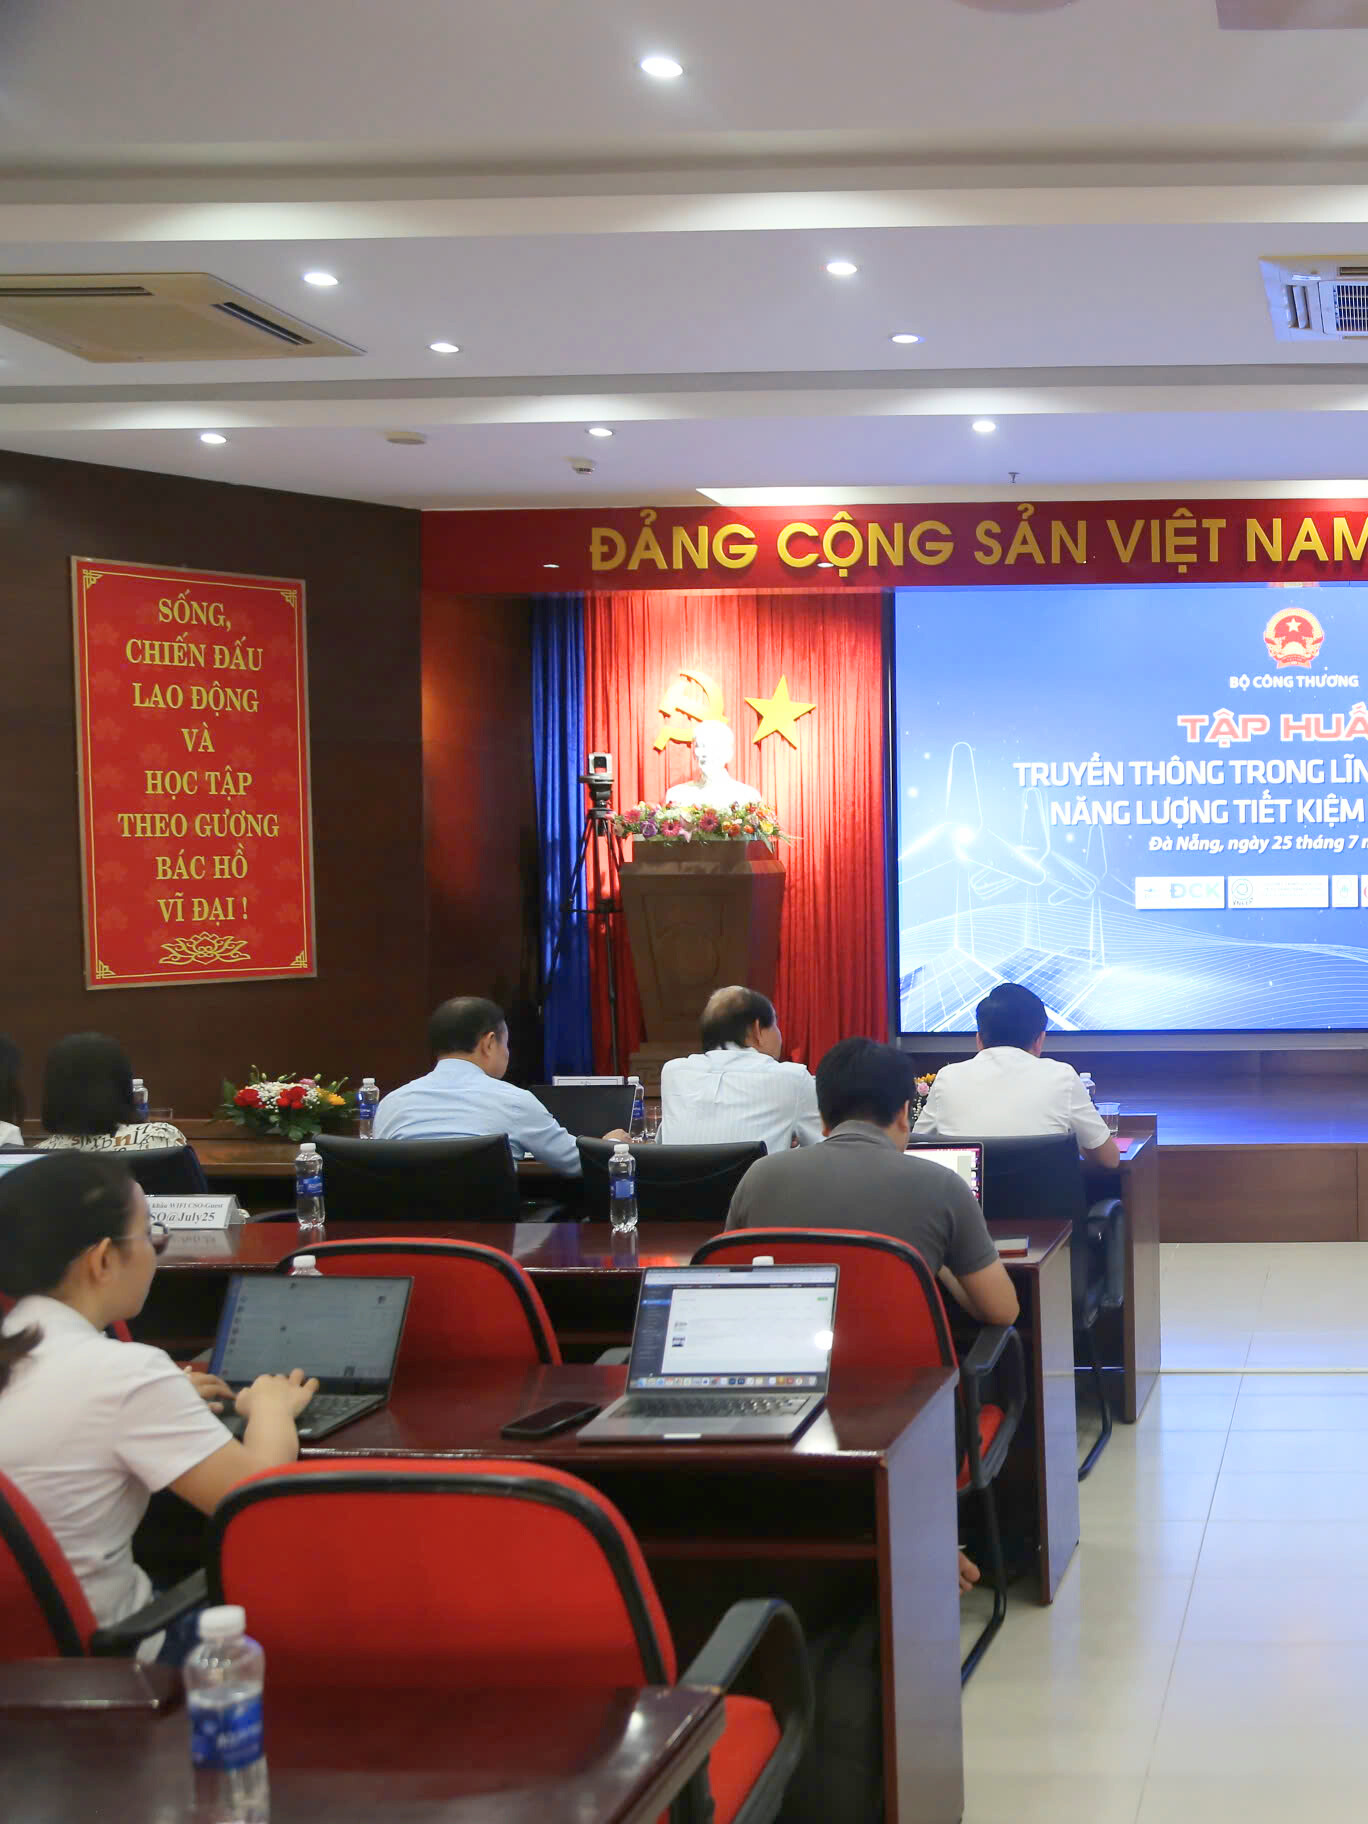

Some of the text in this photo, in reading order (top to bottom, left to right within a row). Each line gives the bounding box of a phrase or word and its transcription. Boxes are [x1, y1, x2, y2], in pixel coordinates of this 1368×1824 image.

[590, 508, 759, 571] ĐẢNG
[777, 510, 954, 577] CỘNG
[974, 503, 1086, 566] SẢN
[1106, 507, 1226, 574] VIỆT
[158, 590, 231, 632] SỐNG,
[125, 632, 263, 670] CHIẾN ĐẤU
[132, 681, 259, 716] LAO ĐỘNG
[1229, 674, 1359, 691] BỘ CÔNG THƯƠNG
[182, 723, 215, 753] VÀ
[1177, 708, 1270, 748] TẬP
[145, 766, 252, 800] HỌC TẬP
[1013, 752, 1124, 787] TRUYỀN
[1129, 755, 1224, 785] THÔNG
[1228, 759, 1325, 784] TRONG
[118, 812, 279, 838] THEO GƯƠNG
[1051, 795, 1131, 825] NĂNG
[1136, 796, 1229, 829] LƯỢNG
[1233, 788, 1292, 824] TIẾT
[1296, 793, 1365, 827] KIỆM
[156, 842, 248, 880] BÁC HỒ
[1149, 835, 1173, 851] Đà
[1176, 833, 1224, 853] Nẵng,
[1227, 836, 1269, 854] ngày
[1272, 835, 1292, 850] 25
[1296, 834, 1344, 853] tháng
[1348, 834, 1359, 849] 7
[158, 893, 184, 922] VĨ
[192, 897, 235, 926] ĐẠI
[150, 1211, 215, 1224] SO@July25
